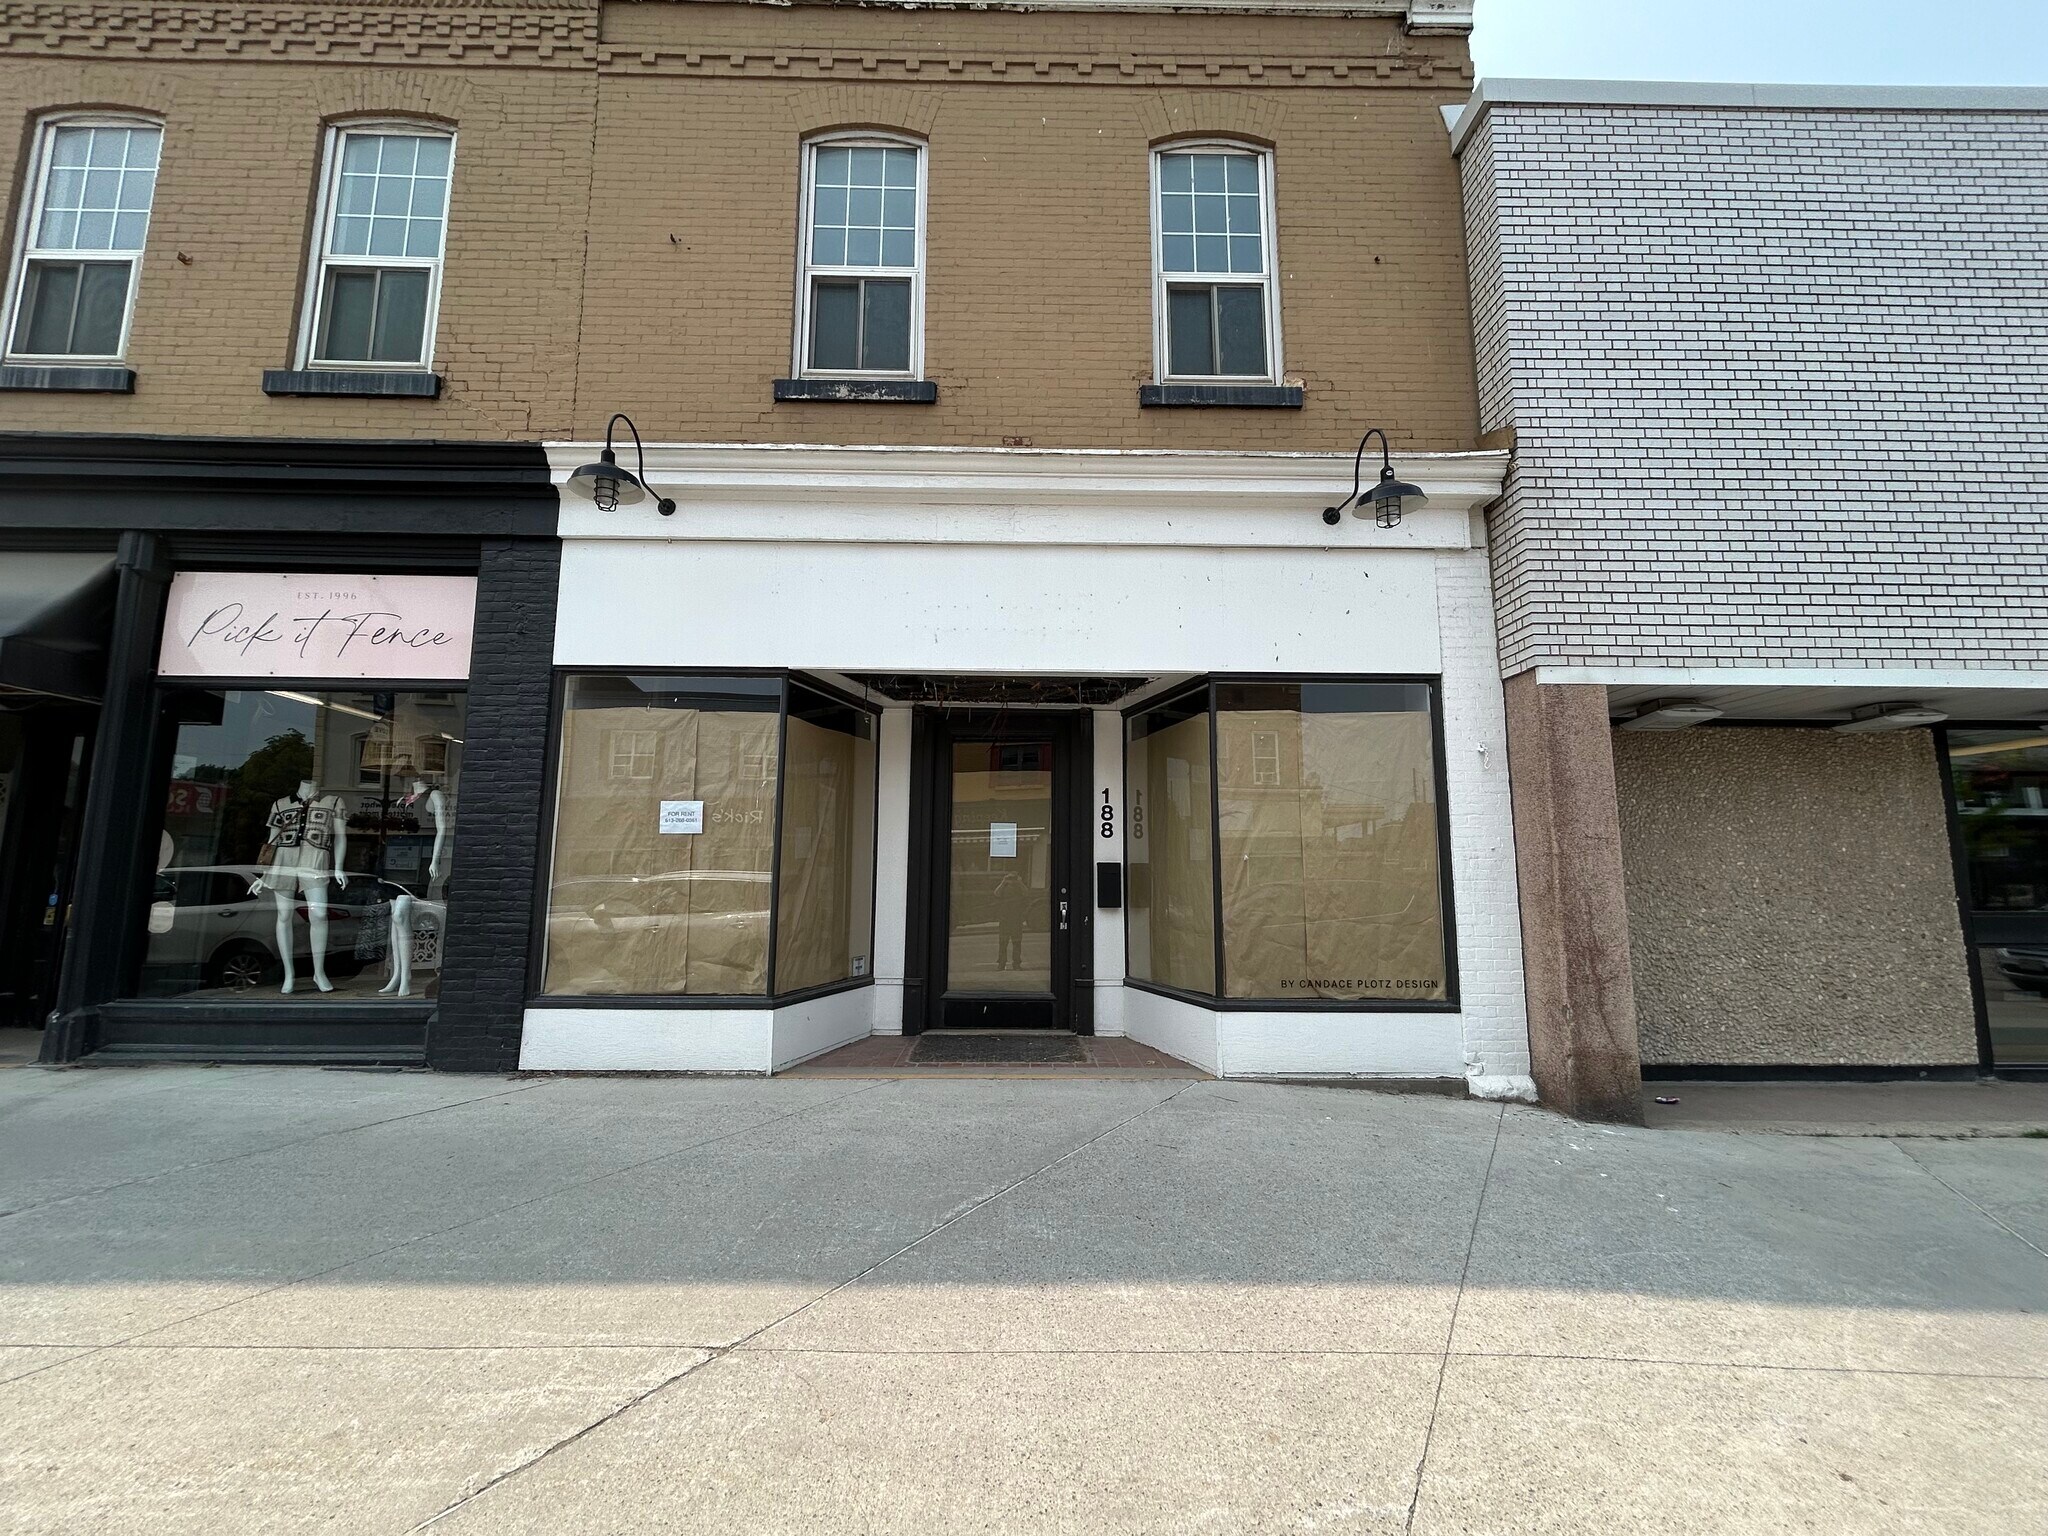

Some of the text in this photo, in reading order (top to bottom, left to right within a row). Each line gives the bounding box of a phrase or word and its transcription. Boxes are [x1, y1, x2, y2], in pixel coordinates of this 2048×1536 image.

[297, 591, 357, 600] EST. 1996
[188, 602, 453, 658] Pick it Fence
[1100, 788, 1114, 838] 188
[1281, 979, 1438, 989] BY CANDACE PLOTZ DESIGN
